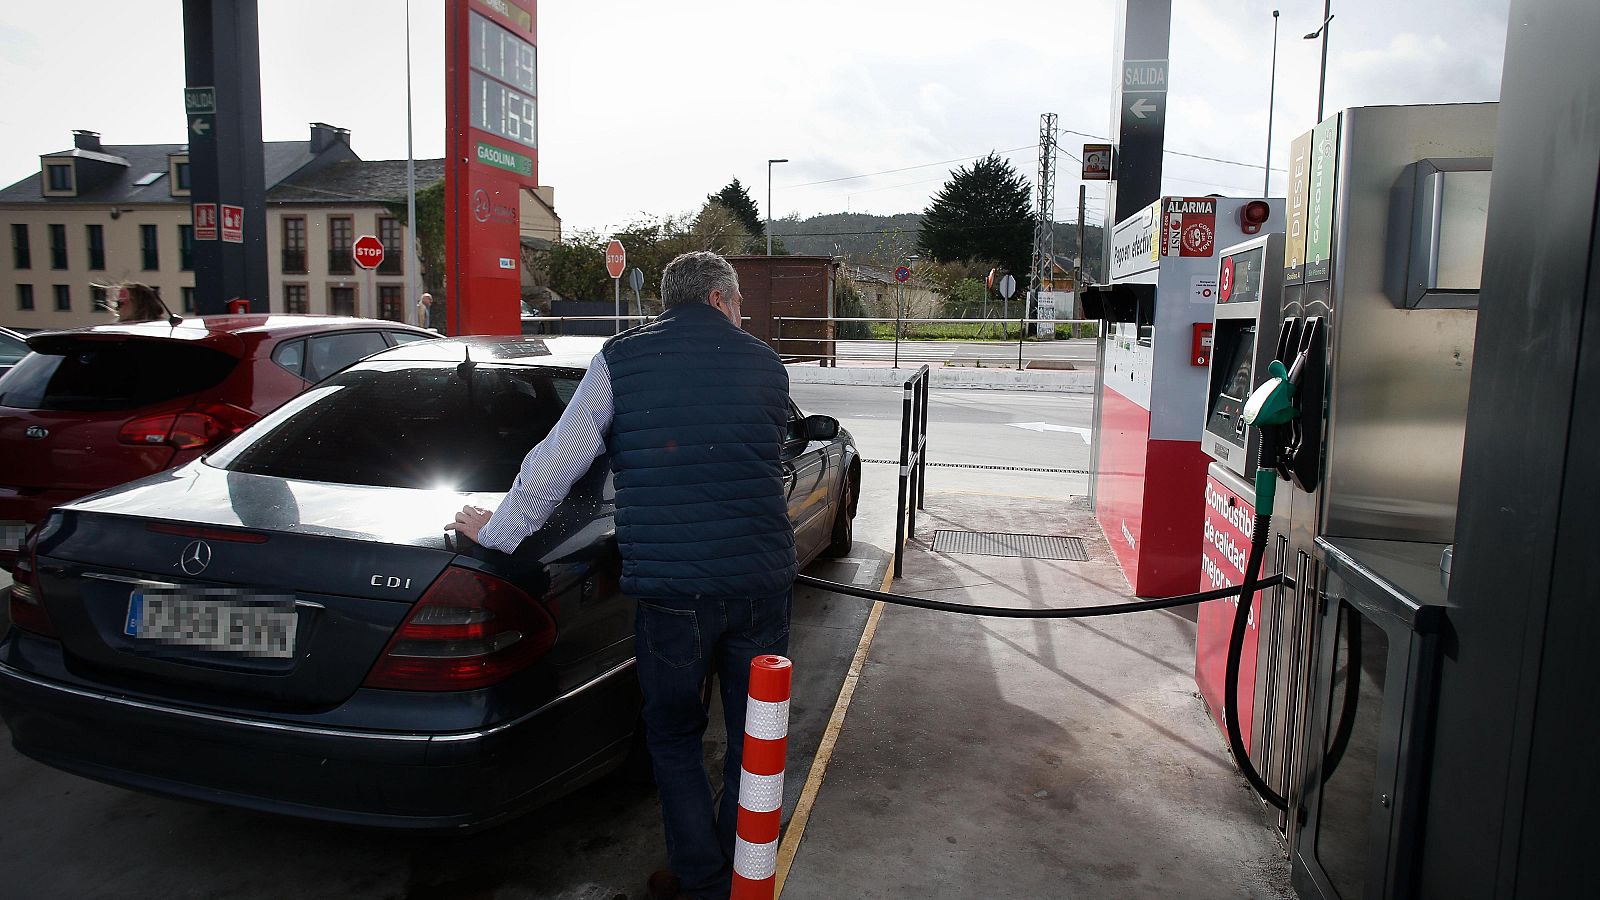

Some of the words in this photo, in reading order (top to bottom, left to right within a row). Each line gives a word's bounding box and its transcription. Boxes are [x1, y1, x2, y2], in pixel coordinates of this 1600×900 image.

[481, 21, 534, 91] 1.179
[1124, 67, 1165, 86] SALIDA
[186, 93, 213, 108] SALIDA
[482, 80, 535, 144] 1.169
[477, 146, 516, 168] GASOLINA
[1291, 146, 1305, 238] DIESEL
[1313, 139, 1325, 244] GASOLINA
[1324, 128, 1333, 158] 95
[1167, 201, 1213, 214] ALARMA
[1114, 245, 1125, 268] Pago
[1125, 244, 1130, 261] en
[1131, 229, 1152, 258] efectiv
[1171, 231, 1181, 251] NST
[1198, 222, 1213, 252] CONECTADA
[357, 247, 382, 257] STOP
[607, 254, 624, 264] STOP
[1223, 267, 1230, 291] 3
[27, 428, 48, 438] KIA
[1205, 482, 1255, 541] Combustibl
[1204, 516, 1215, 543] de
[1214, 530, 1246, 575] calidad
[370, 574, 411, 589] CDI
[1202, 552, 1225, 589] mejor
